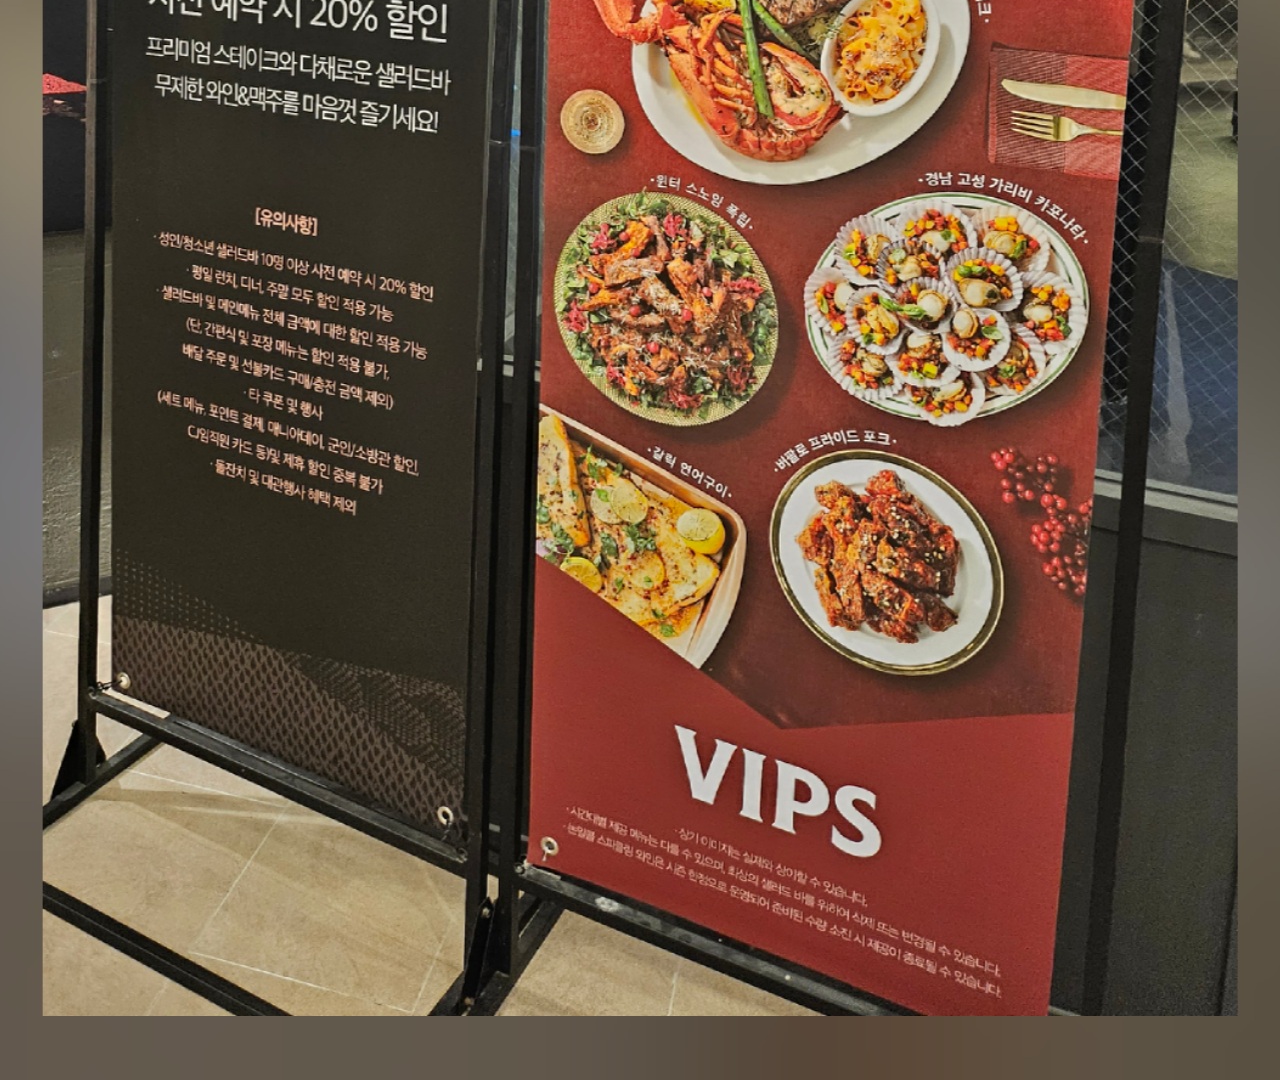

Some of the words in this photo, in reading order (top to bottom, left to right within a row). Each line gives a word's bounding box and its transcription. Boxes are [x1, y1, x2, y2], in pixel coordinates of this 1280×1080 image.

[145, 36, 211, 66] 프리미엄
[213, 44, 298, 76] 스테이크와
[300, 52, 373, 85] 다채로운
[375, 61, 452, 96] 샐러드바
[154, 73, 203, 102] 무제한
[206, 79, 300, 117] 와인&맥주를
[302, 93, 358, 125] 마음껏
[359, 100, 439, 134] 즐기세요!
[255, 207, 318, 237] [유의사항]
[925, 172, 953, 187] 경남
[957, 172, 985, 189] 고성
[988, 177, 1033, 203] 가리비
[1033, 194, 1087, 241] 카포나타
[192, 265, 213, 282] 평일
[266, 281, 289, 300] 주말
[291, 287, 314, 304] 모두
[316, 292, 340, 311] 할인
[343, 297, 366, 317] 적용
[369, 303, 394, 322] 가능
[216, 242, 258, 265] 샐러드바
[261, 252, 284, 271] 10명
[286, 258, 310, 276] 이상
[311, 263, 336, 281] 사전
[337, 268, 362, 288] 예약
[364, 273, 377, 290] 시
[379, 276, 407, 294] 20%
[409, 281, 434, 303] 할인
[807, 428, 861, 450] 프라이드
[863, 429, 891, 446] 포크
[679, 460, 729, 499] 연어구이
[673, 724, 882, 858] VIPS
